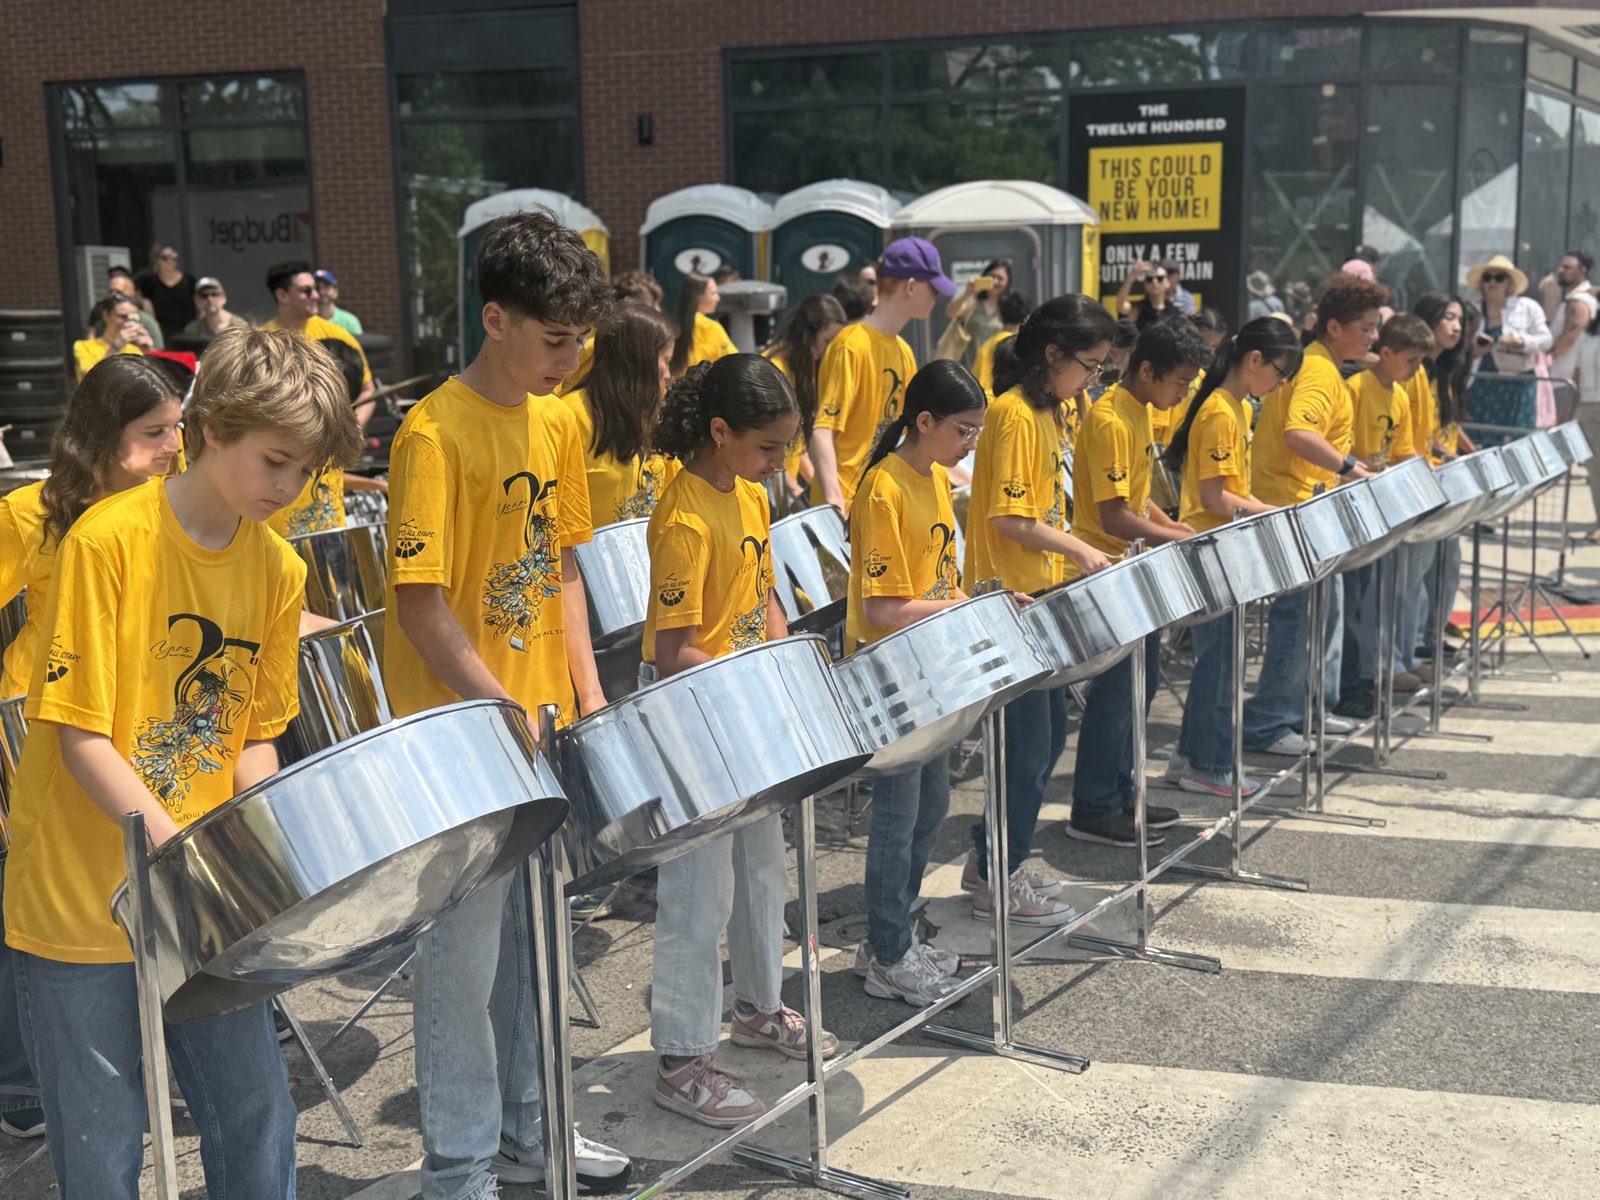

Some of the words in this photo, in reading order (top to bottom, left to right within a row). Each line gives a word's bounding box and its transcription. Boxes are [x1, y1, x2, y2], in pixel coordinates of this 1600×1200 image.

[1138, 103, 1169, 117] THE
[1086, 122, 1148, 137] TWELVE
[1150, 117, 1227, 134] HUNDRED
[1099, 157, 1142, 179] THIS
[1149, 154, 1211, 177] COULD
[1114, 179, 1137, 200] BE
[1145, 176, 1195, 198] YOUR
[1099, 200, 1140, 221] NEW
[1148, 197, 1209, 220] HOME!
[1105, 244, 1146, 264] ONLY
[1150, 243, 1161, 262] A
[1165, 242, 1200, 262] FEW
